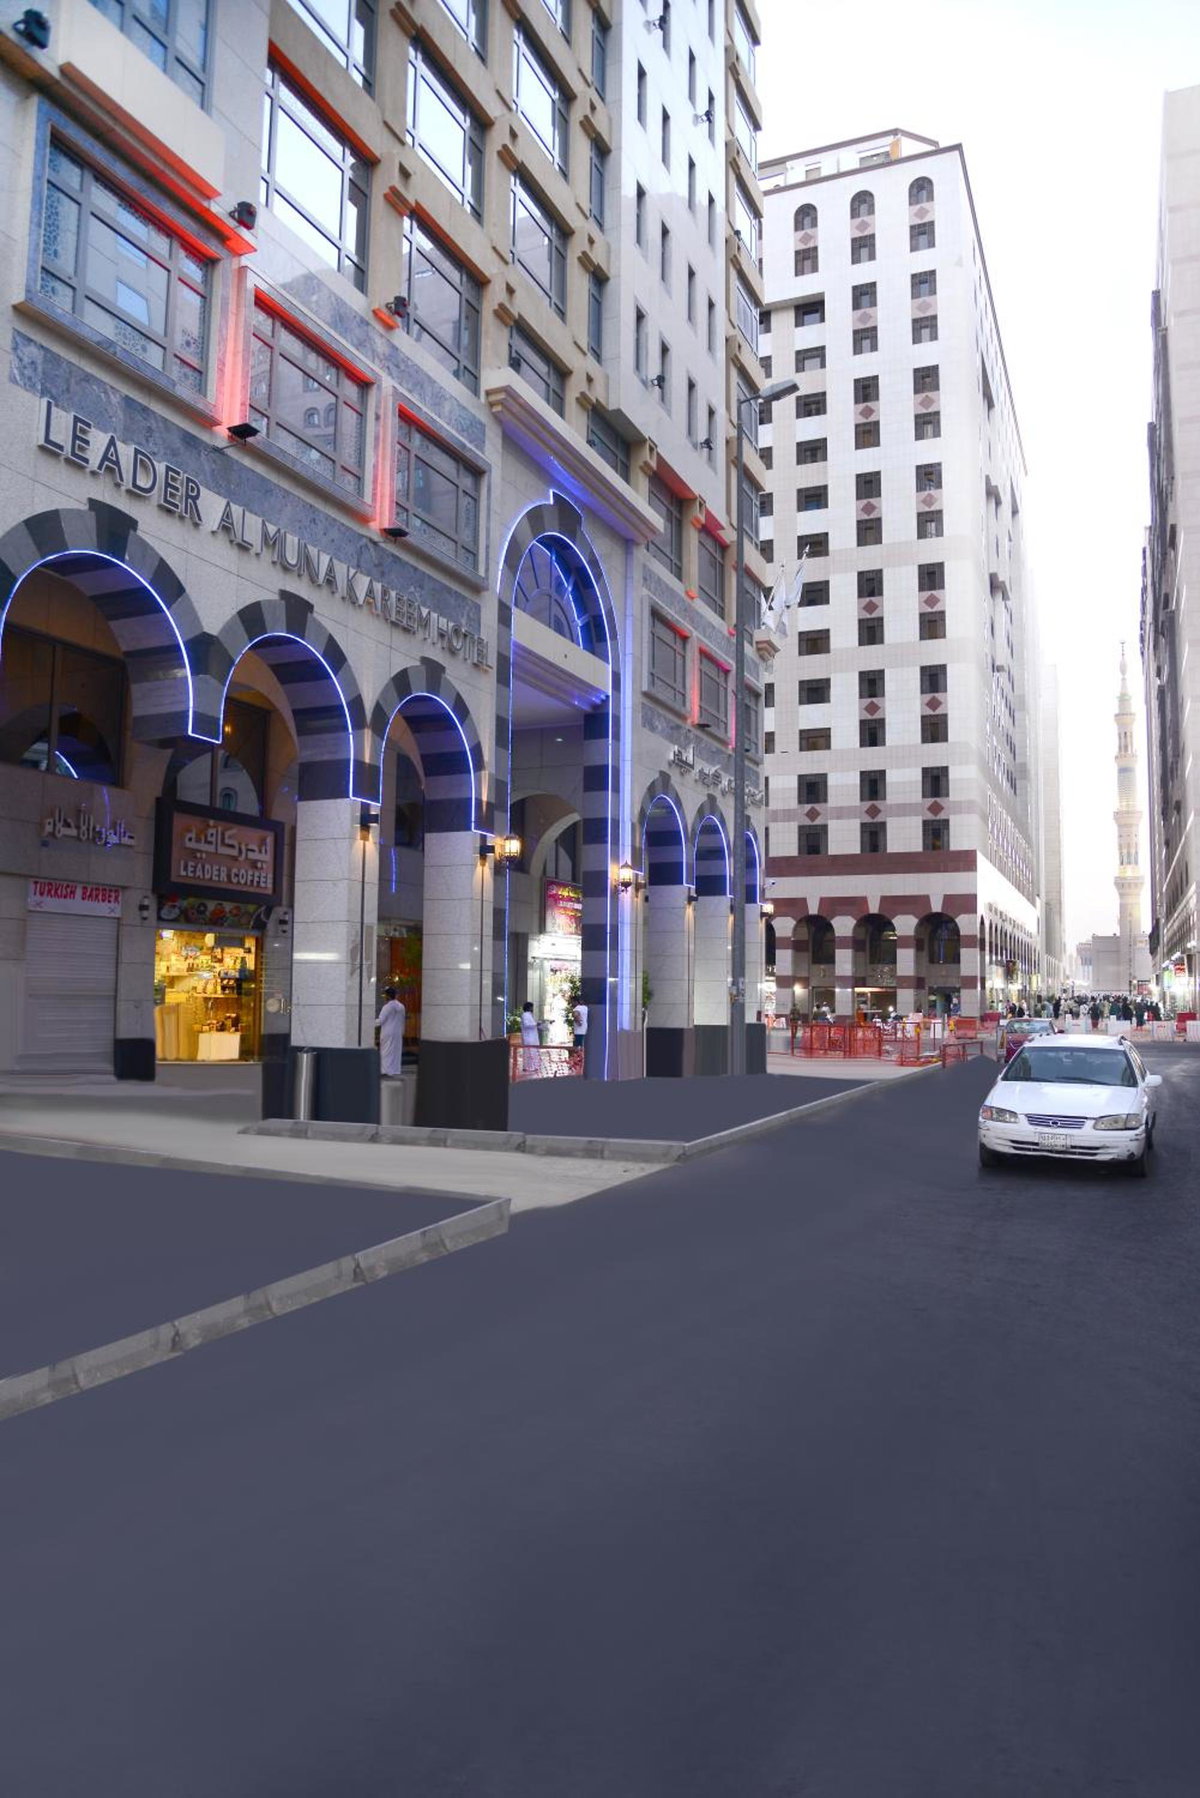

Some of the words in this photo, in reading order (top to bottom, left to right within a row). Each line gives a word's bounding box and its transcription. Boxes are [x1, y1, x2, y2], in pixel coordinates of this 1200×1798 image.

[39, 397, 203, 527] LEADER
[343, 569, 432, 643] KAREEM
[432, 611, 493, 673] HOTEL
[95, 818, 137, 849] صالون
[180, 859, 228, 882] LEADER
[231, 867, 273, 888] COFFEE
[33, 880, 77, 900] TURKISH
[81, 885, 121, 905] BARBER
